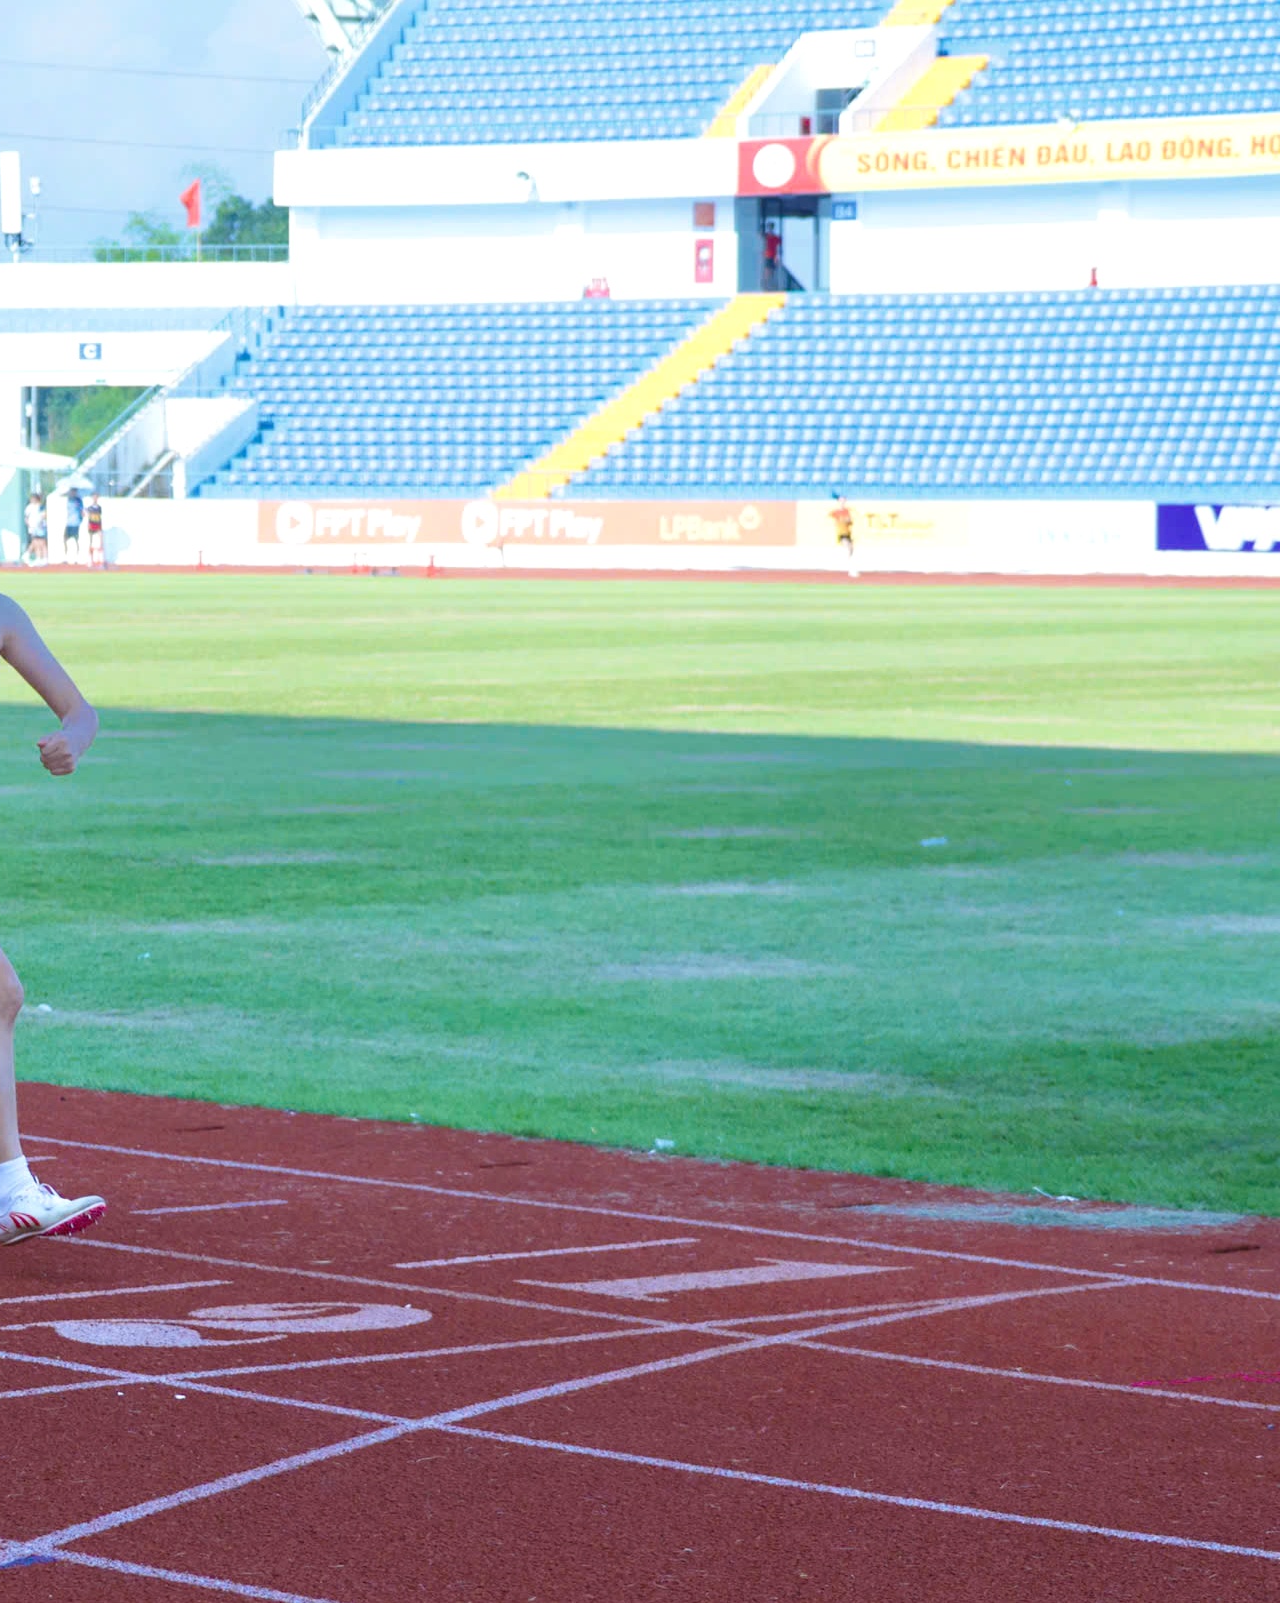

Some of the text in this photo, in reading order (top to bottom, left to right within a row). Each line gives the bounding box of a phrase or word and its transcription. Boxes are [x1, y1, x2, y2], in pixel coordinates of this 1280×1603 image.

[1107, 141, 1151, 162] LAO
[316, 508, 422, 543] FPT Play
[499, 508, 603, 544] FPT Play
[660, 514, 741, 541] LPBank
